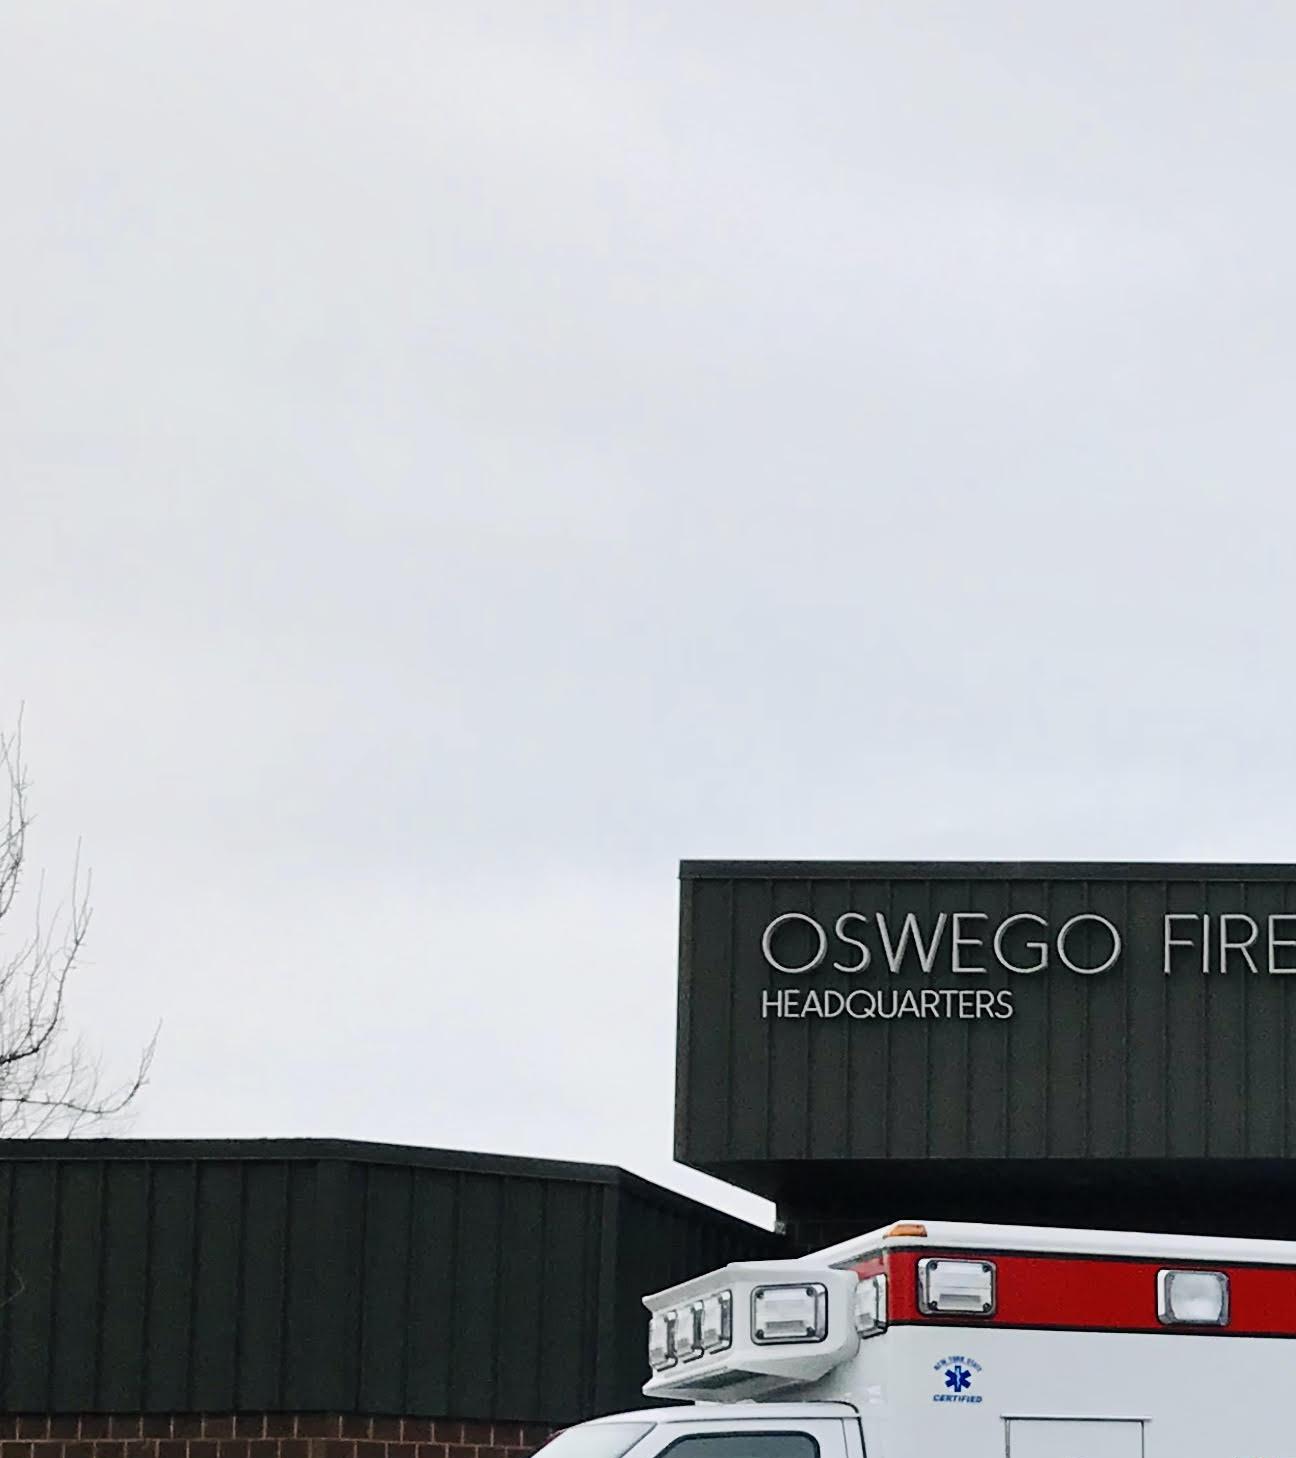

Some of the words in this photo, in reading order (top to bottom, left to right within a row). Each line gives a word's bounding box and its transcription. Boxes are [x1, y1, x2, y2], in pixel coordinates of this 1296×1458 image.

[762, 912, 1122, 974] OSWEGO
[762, 990, 1013, 1018] HEADQUARTERS
[933, 1394, 983, 1403] CERTIFIED
